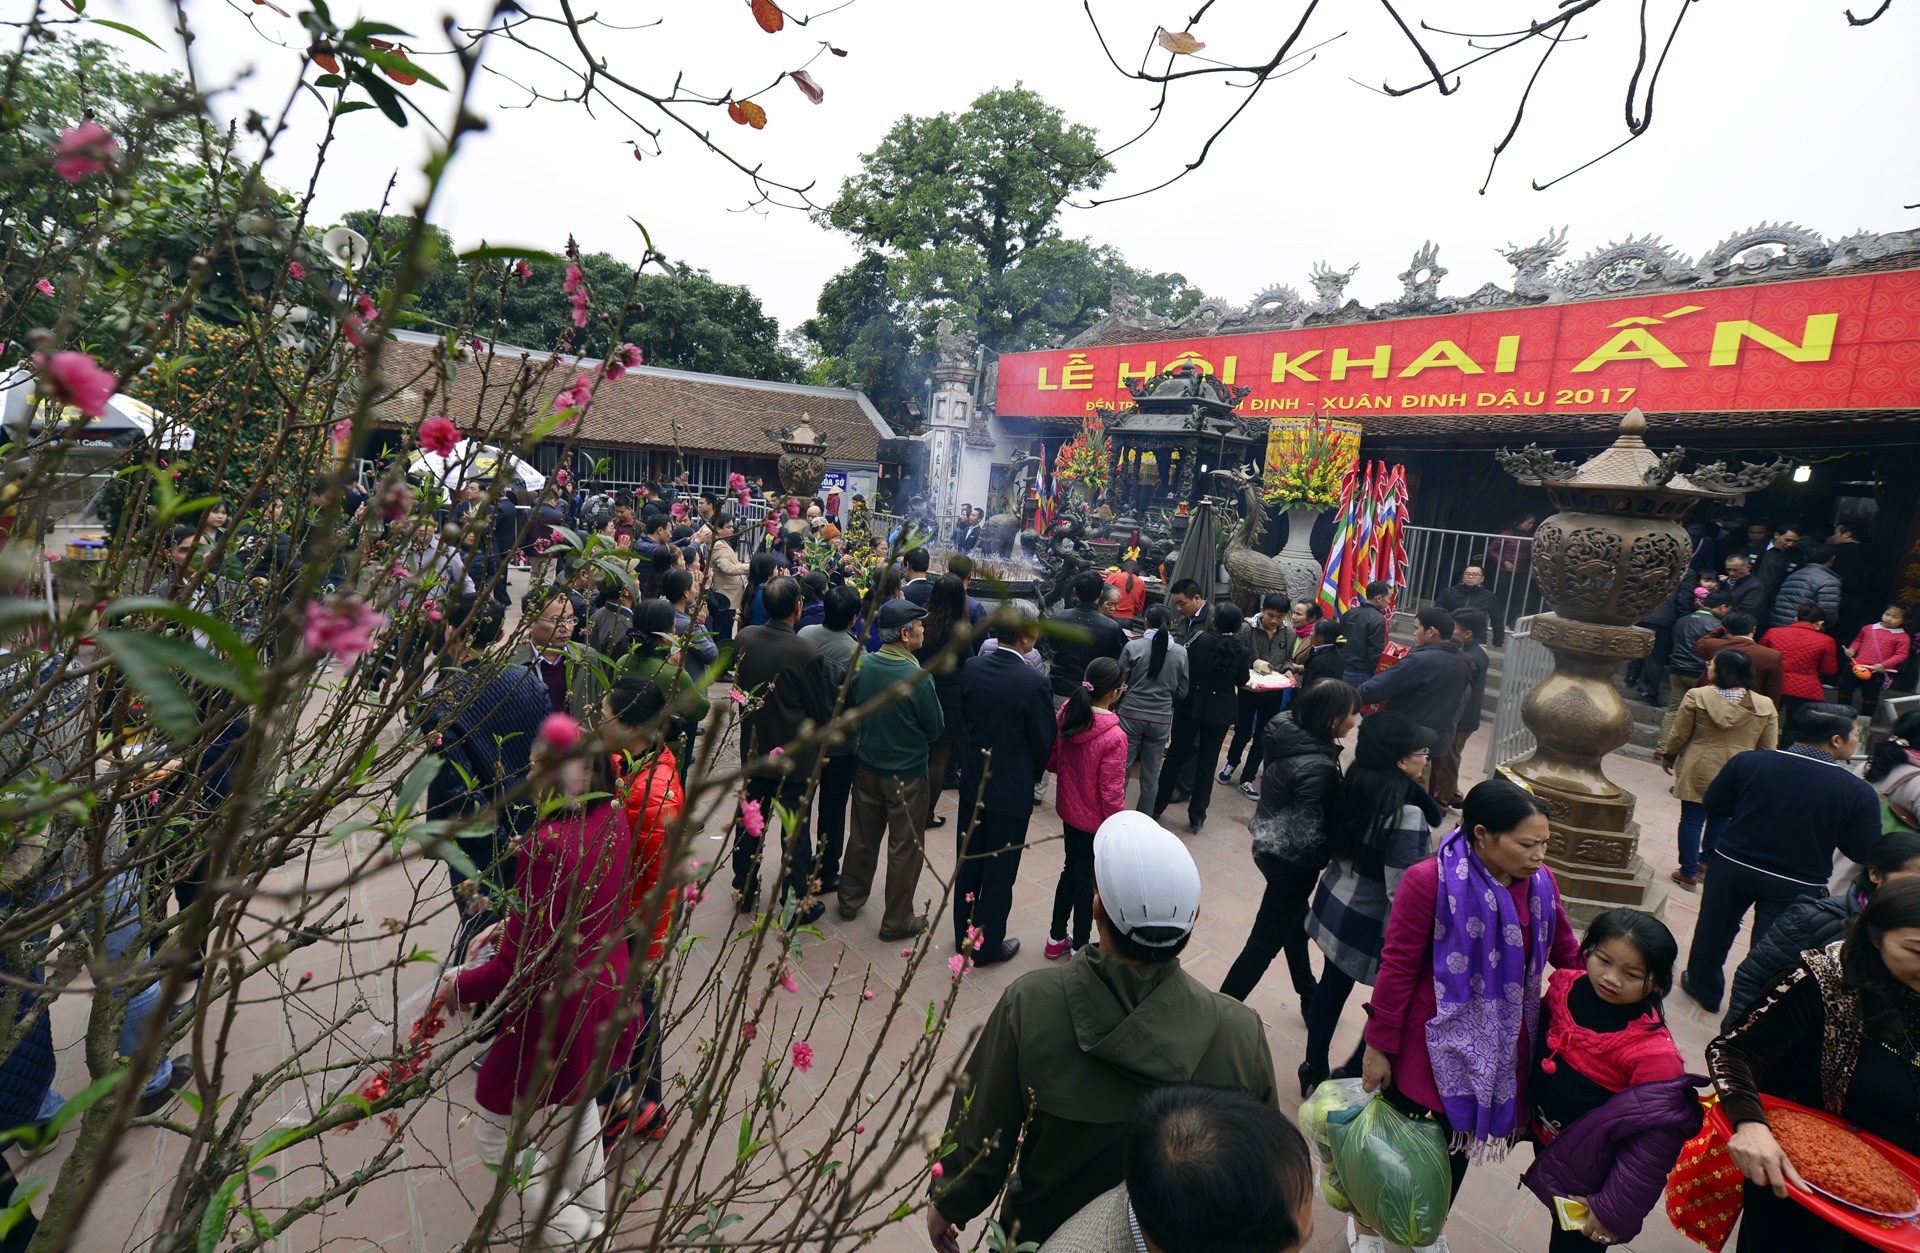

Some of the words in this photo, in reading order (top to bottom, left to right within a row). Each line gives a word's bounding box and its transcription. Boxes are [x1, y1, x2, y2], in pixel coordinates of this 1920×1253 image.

[1037, 353, 1095, 391] LỄ
[1270, 334, 1521, 383] KHAI
[1570, 305, 1840, 373] ẤN
[1250, 398, 1300, 413] ĐỊNH
[1321, 394, 1393, 410] XUÂN
[1401, 393, 1467, 408] ĐINH
[1476, 388, 1546, 410] DẬU
[1555, 387, 1637, 405] 2017
[81, 439, 114, 448] Coffee
